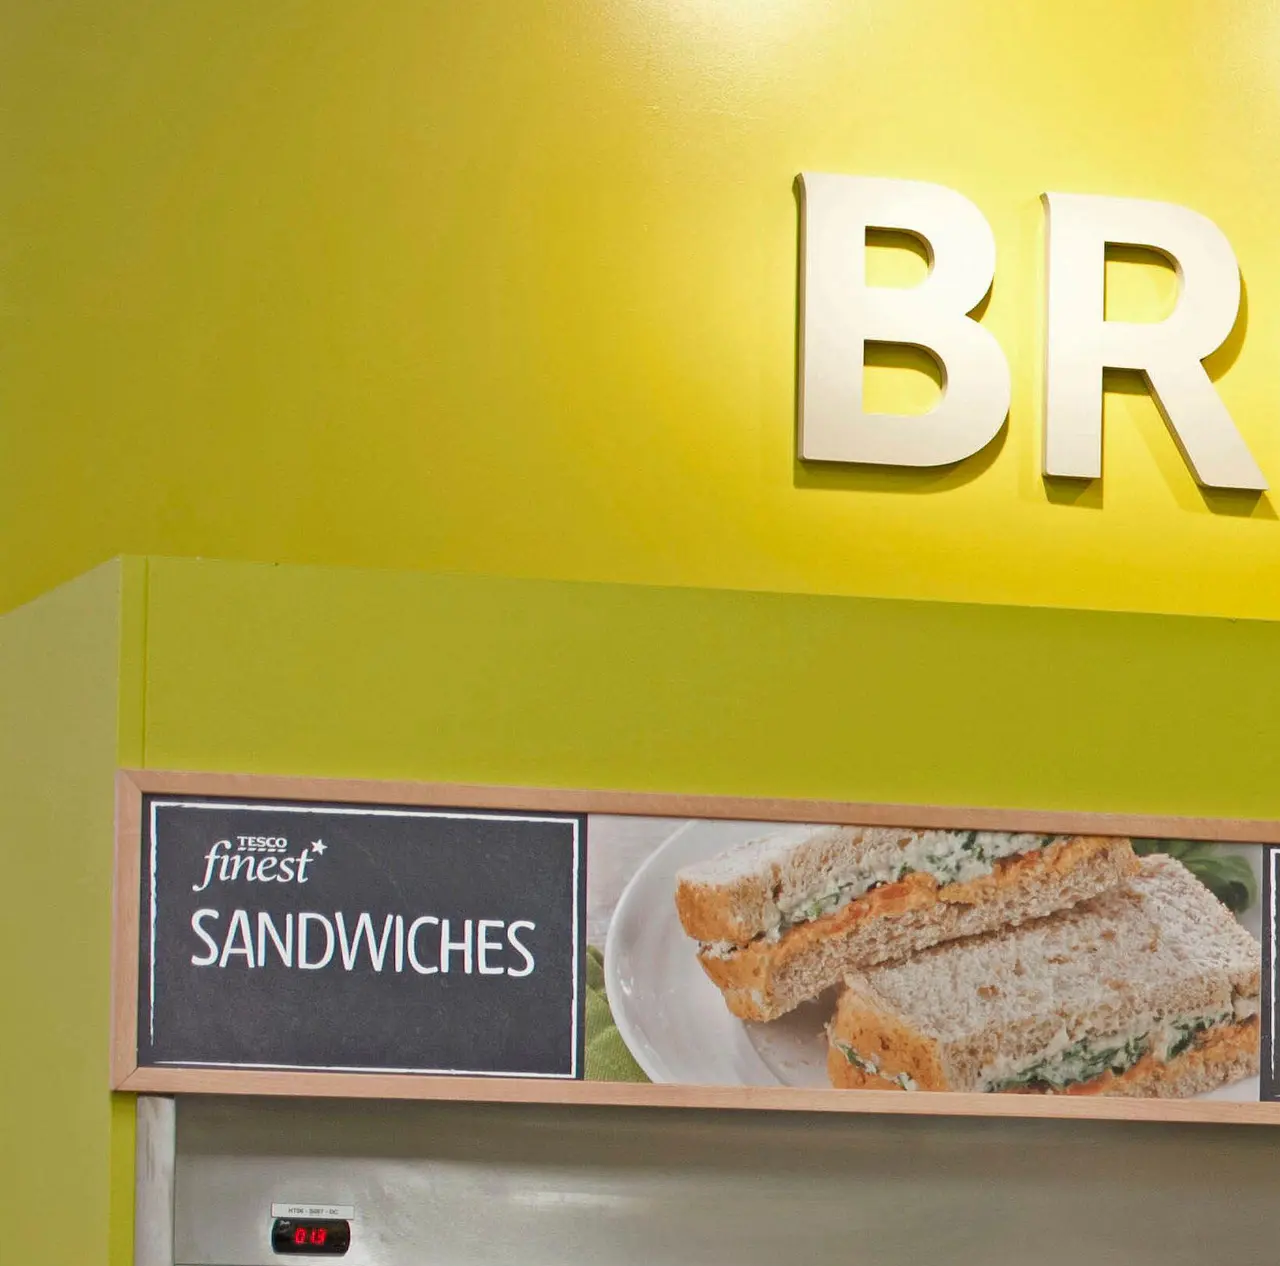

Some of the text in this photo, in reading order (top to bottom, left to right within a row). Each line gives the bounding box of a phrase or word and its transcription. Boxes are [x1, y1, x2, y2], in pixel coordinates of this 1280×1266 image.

[192, 840, 314, 891] finest
[237, 836, 288, 852] TESCO
[191, 909, 536, 977] SANDWICHES
